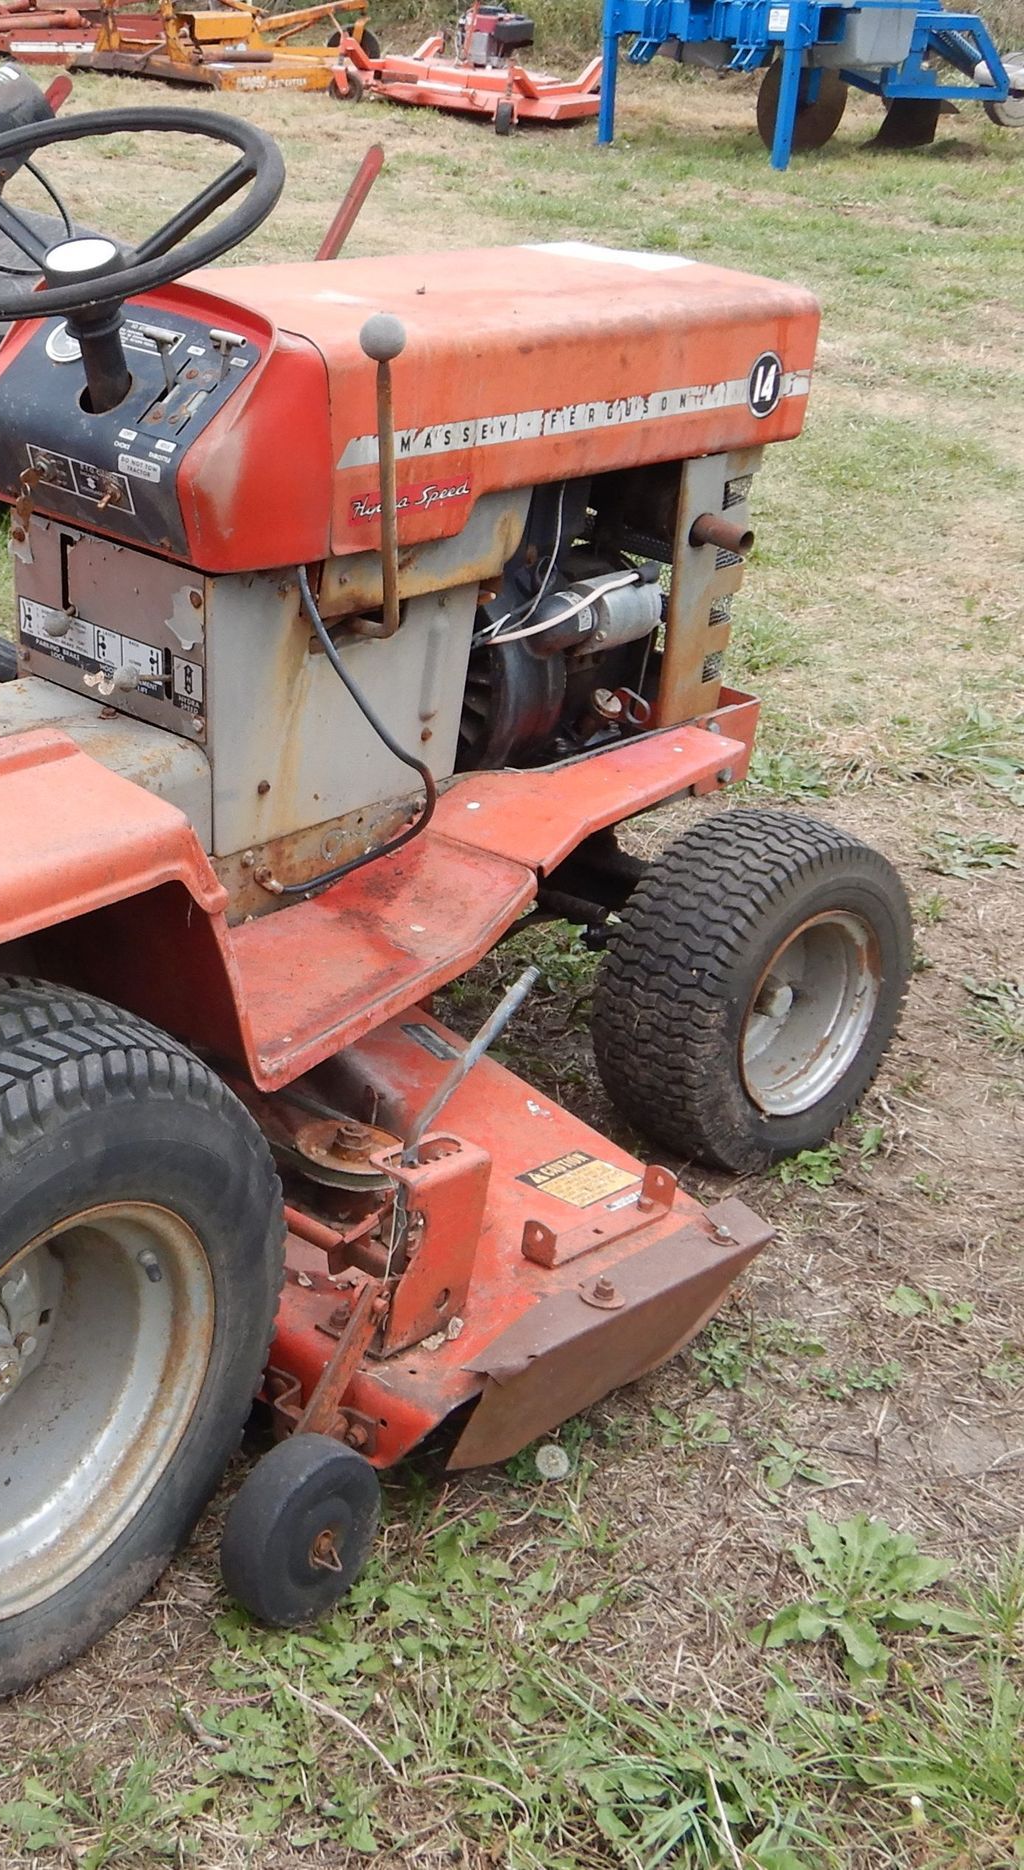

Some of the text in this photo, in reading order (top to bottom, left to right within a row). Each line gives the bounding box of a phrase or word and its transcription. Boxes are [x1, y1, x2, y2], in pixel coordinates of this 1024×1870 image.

[752, 364, 777, 404] 14
[399, 396, 687, 453] MASSEY FERGUSON
[120, 456, 158, 472] DO NOT TOW
[127, 465, 151, 477] TRACTOR
[415, 477, 472, 509] Speed
[35, 638, 80, 661] PARKING BRAKE
[50, 650, 65, 662] LOCK
[178, 694, 201, 709] HYDRA
[180, 702, 199, 715] SPEED
